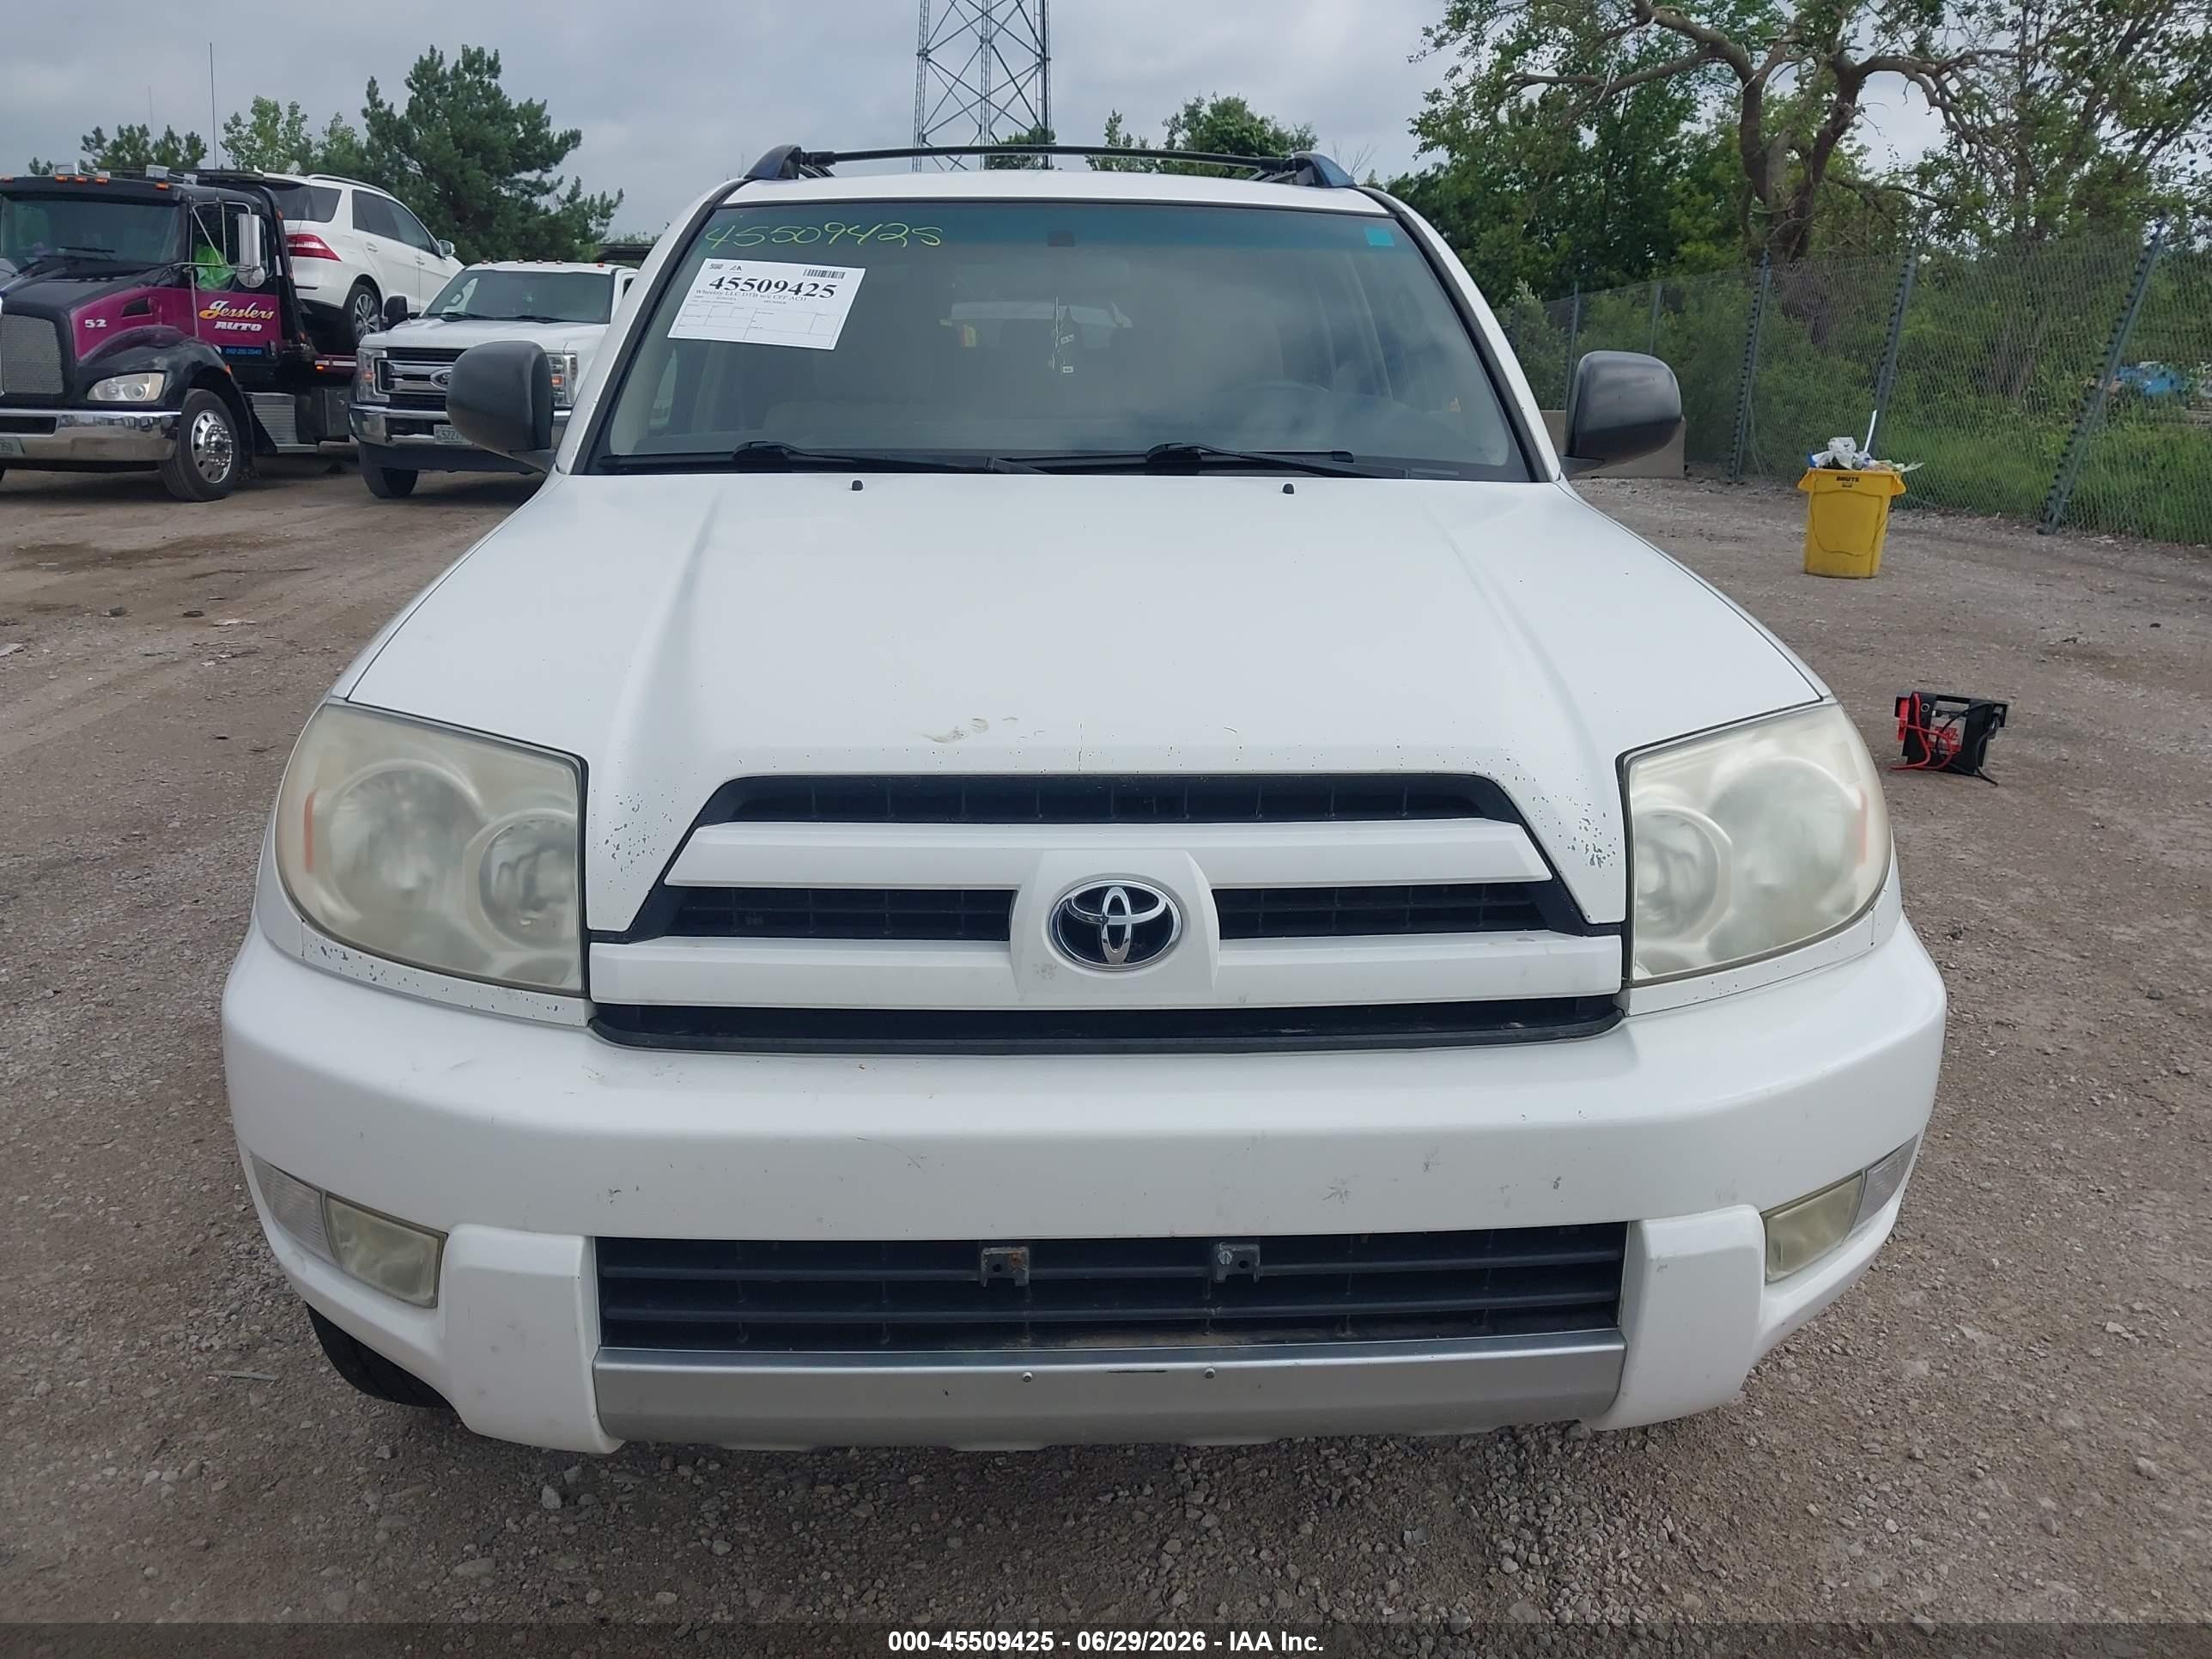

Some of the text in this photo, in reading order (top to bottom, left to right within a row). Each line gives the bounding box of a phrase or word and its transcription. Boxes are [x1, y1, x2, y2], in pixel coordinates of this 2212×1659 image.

[704, 222, 943, 249] 45509425
[708, 276, 838, 299] 45509425
[84, 319, 107, 328] 52
[214, 320, 262, 331] AUTO
